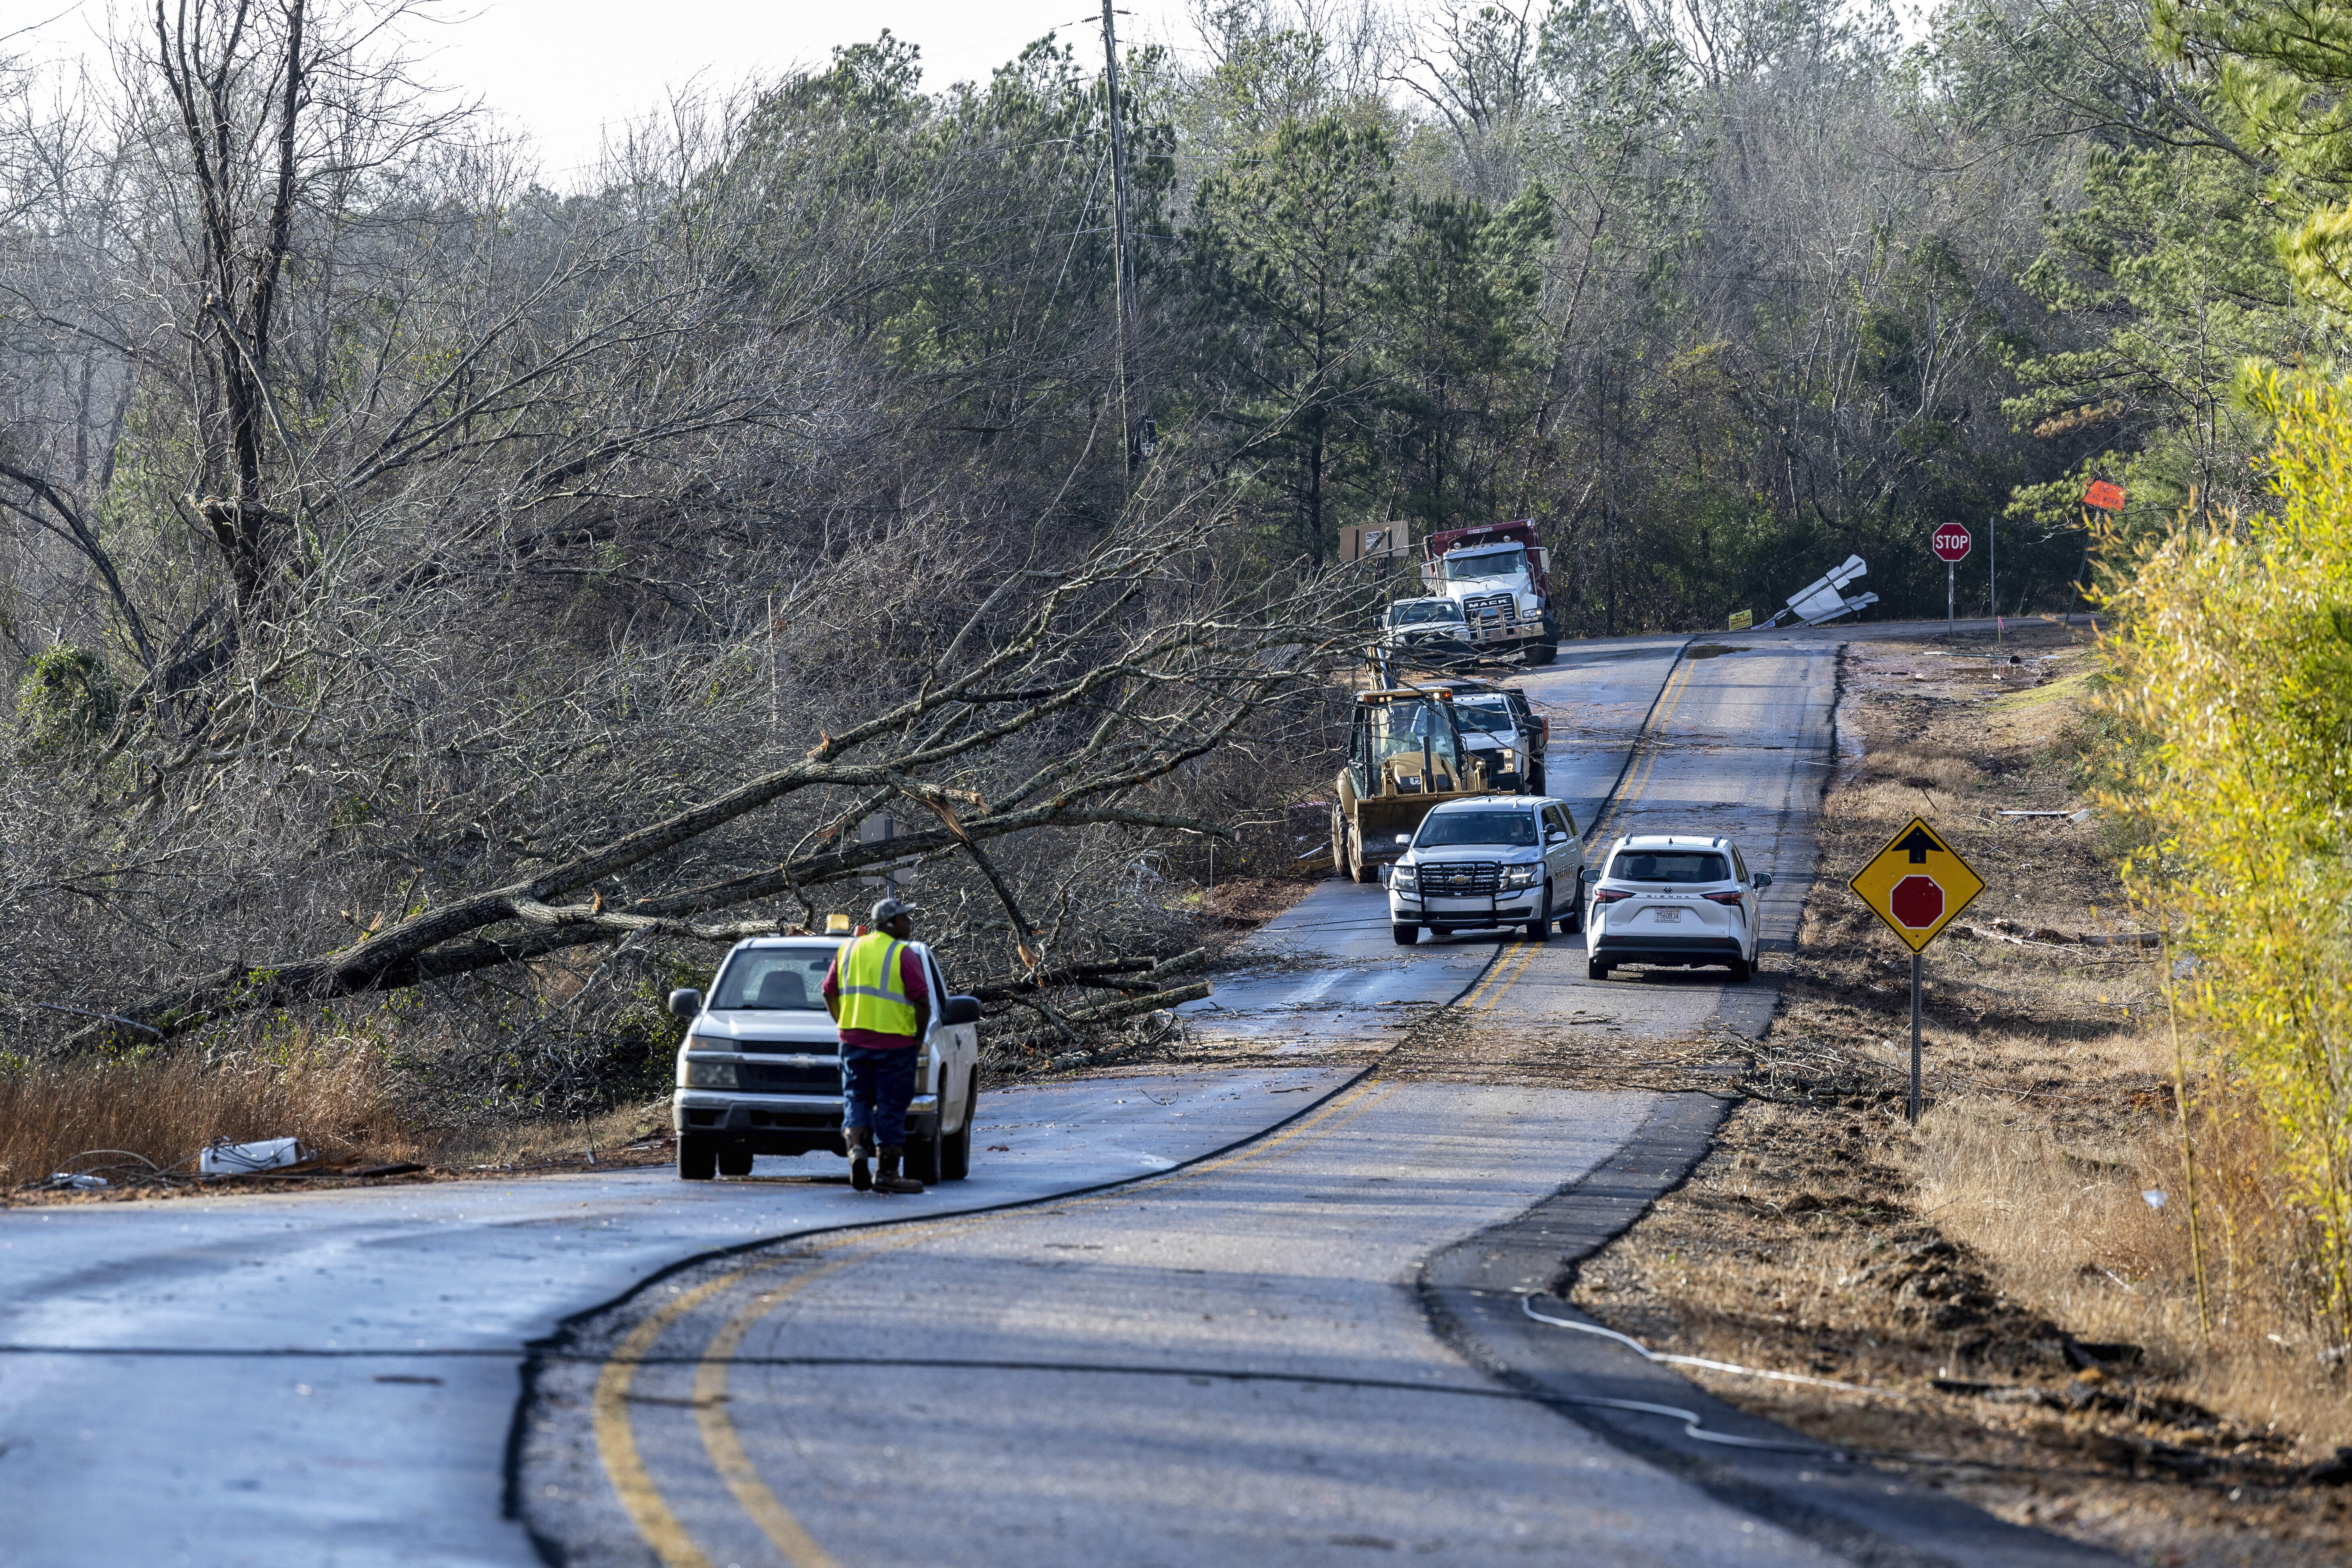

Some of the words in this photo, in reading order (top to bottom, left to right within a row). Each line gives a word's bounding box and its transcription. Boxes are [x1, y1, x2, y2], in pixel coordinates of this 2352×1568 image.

[2098, 486, 2110, 495] END
[2103, 496, 2119, 506] WORK
[1936, 535, 1968, 549] STOP
[1469, 599, 1508, 608] MACK
[1555, 862, 1574, 880] SHERIFF
